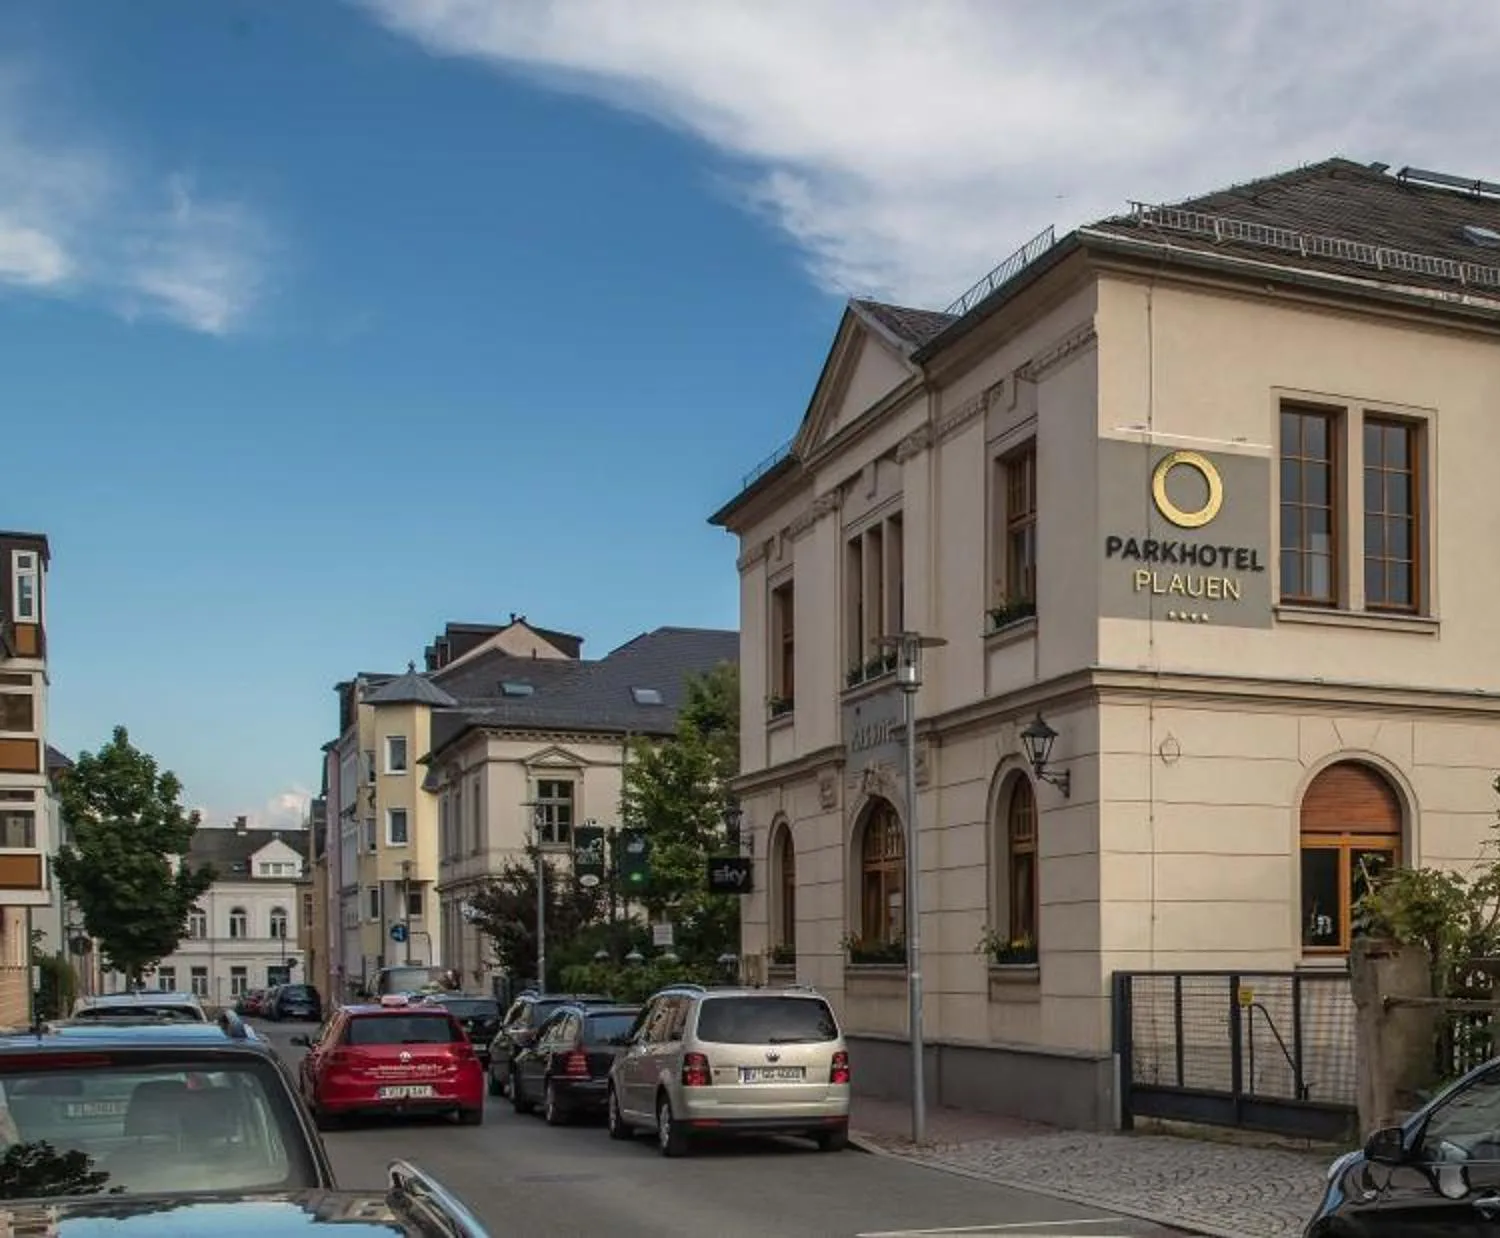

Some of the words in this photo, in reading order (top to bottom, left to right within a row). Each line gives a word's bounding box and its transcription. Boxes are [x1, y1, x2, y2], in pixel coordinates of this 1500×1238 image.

[1105, 535, 1265, 572] PARKHOTEL
[1134, 569, 1241, 600] PLAUEN
[712, 865, 747, 887] sky
